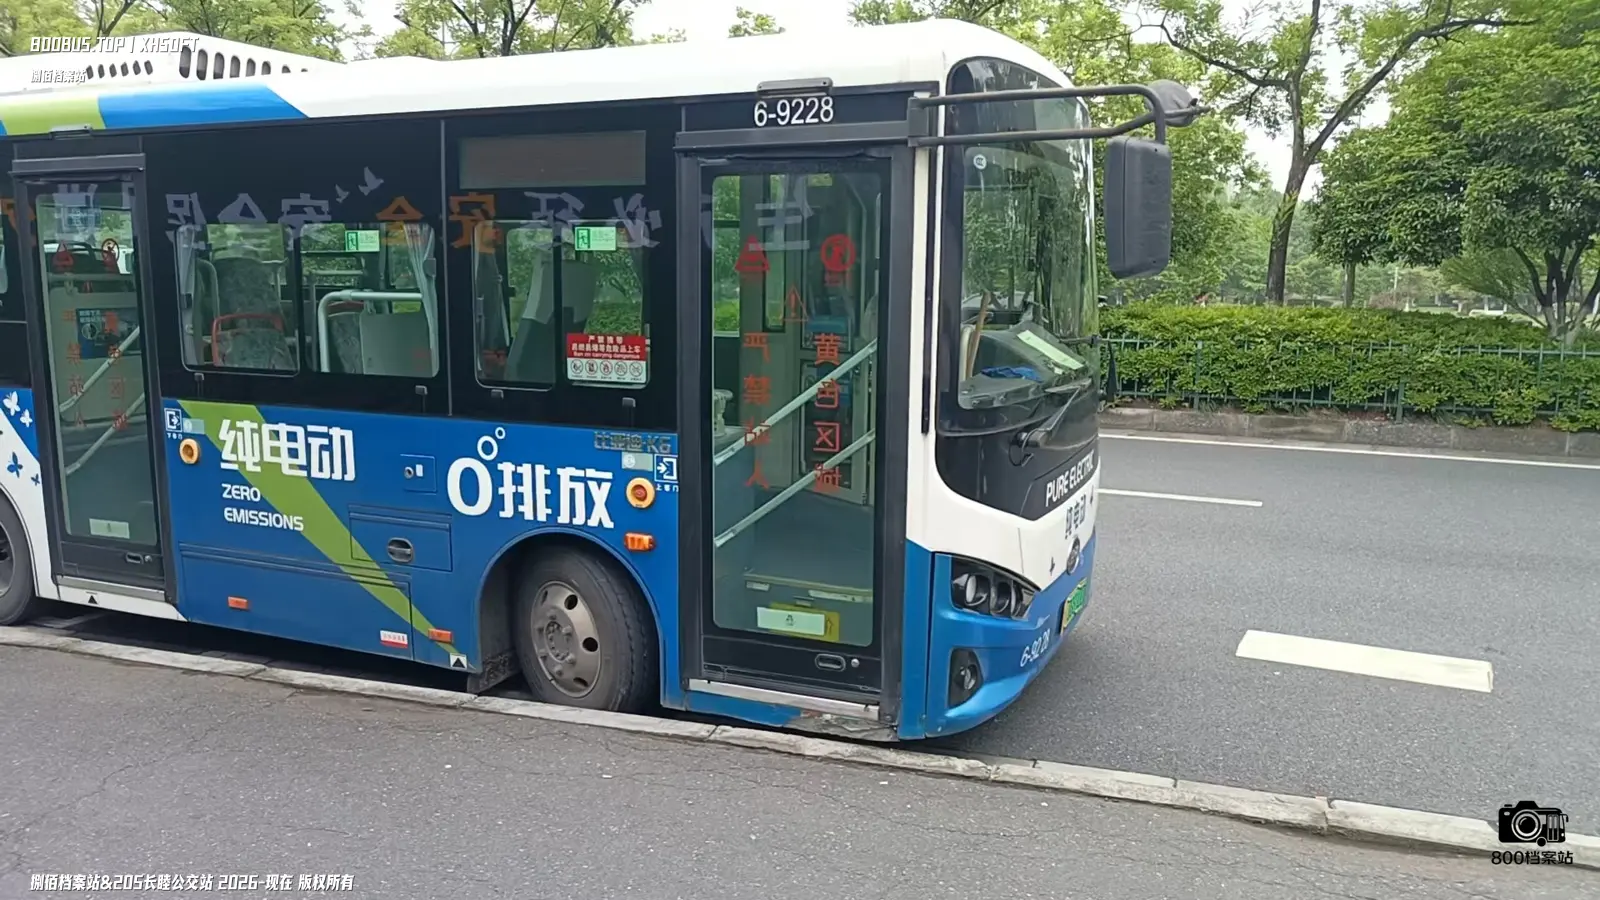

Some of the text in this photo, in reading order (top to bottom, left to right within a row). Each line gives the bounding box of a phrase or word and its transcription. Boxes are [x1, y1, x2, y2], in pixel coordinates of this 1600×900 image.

[754, 96, 833, 126] 6-9228
[218, 419, 355, 481] 纯电动
[221, 483, 261, 502] ZERO
[1045, 470, 1069, 508] PURE
[224, 507, 304, 532] EMISSIONS
